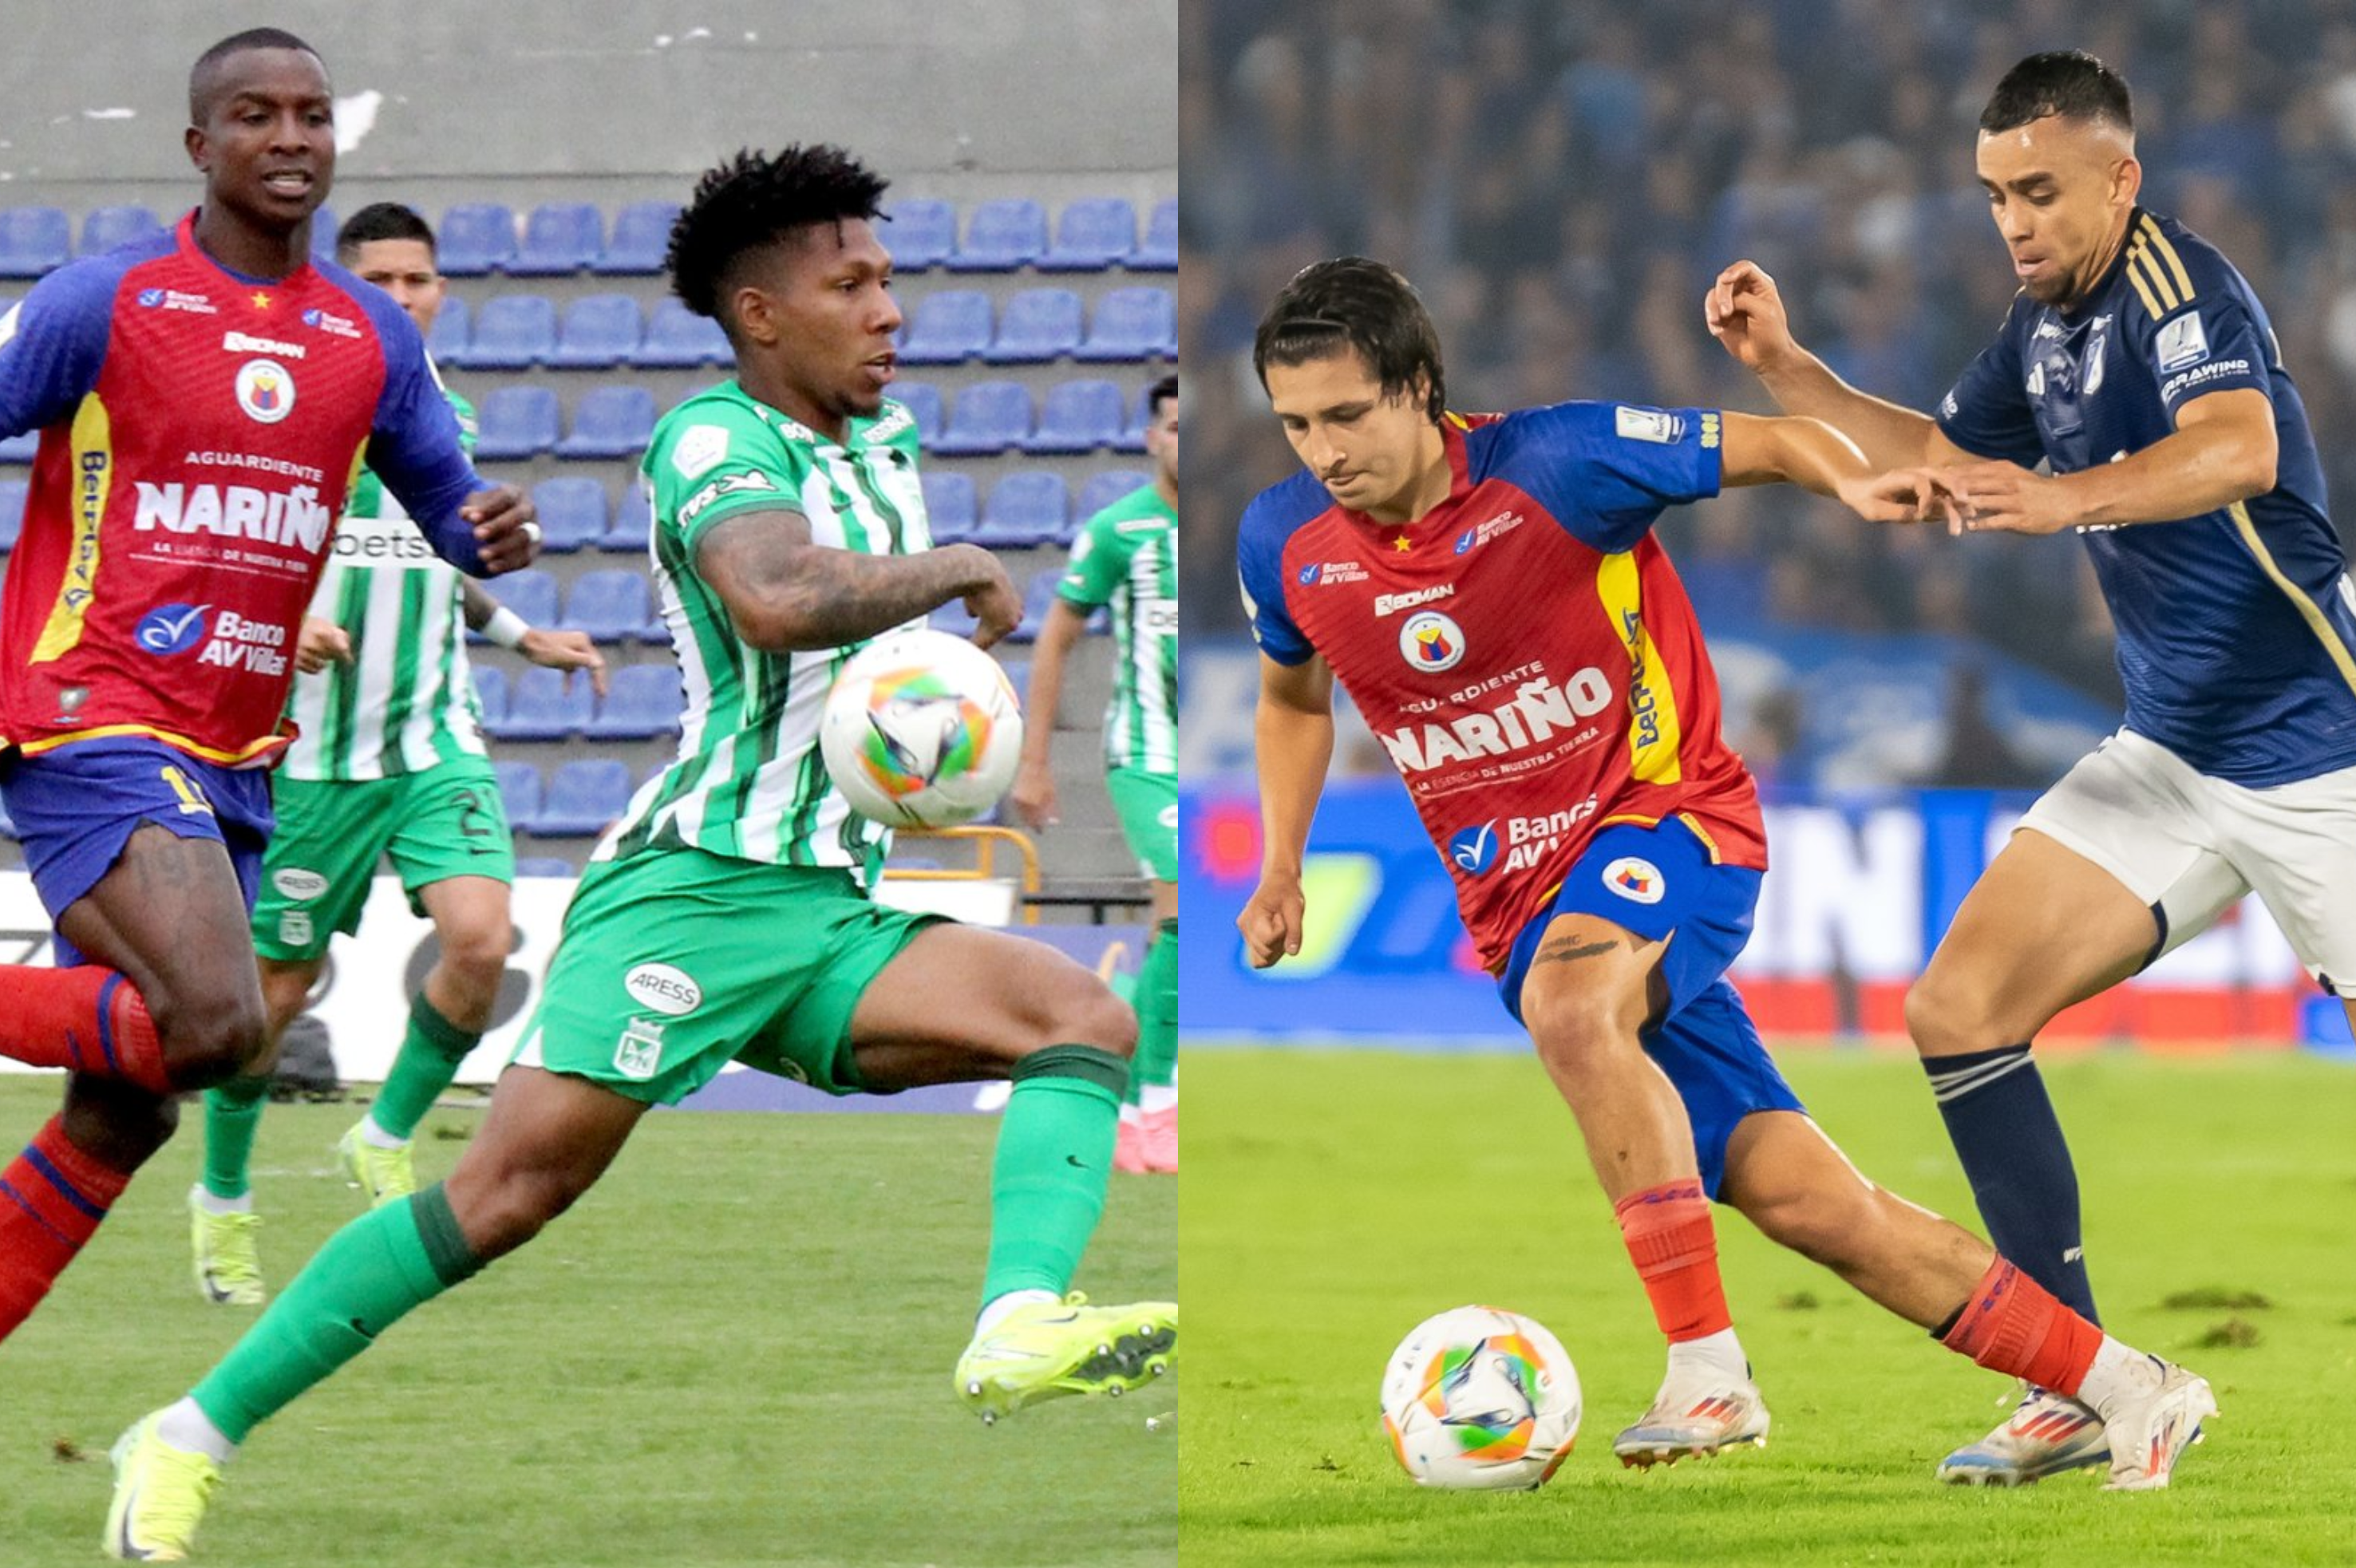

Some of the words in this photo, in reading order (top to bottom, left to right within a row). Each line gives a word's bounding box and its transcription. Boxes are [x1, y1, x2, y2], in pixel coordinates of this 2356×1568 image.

[184, 451, 324, 482] AGUARDIENTE
[1476, 511, 1512, 535] Banco
[1322, 562, 1360, 574] Banco
[214, 610, 286, 647] Banco
[1400, 660, 1545, 714] GURDIENTE
[1380, 666, 1613, 774] NARIÑO
[1499, 751, 1556, 774] NUESTRA
[1556, 726, 1599, 755] TIERRA
[631, 973, 696, 1005] ARESS
